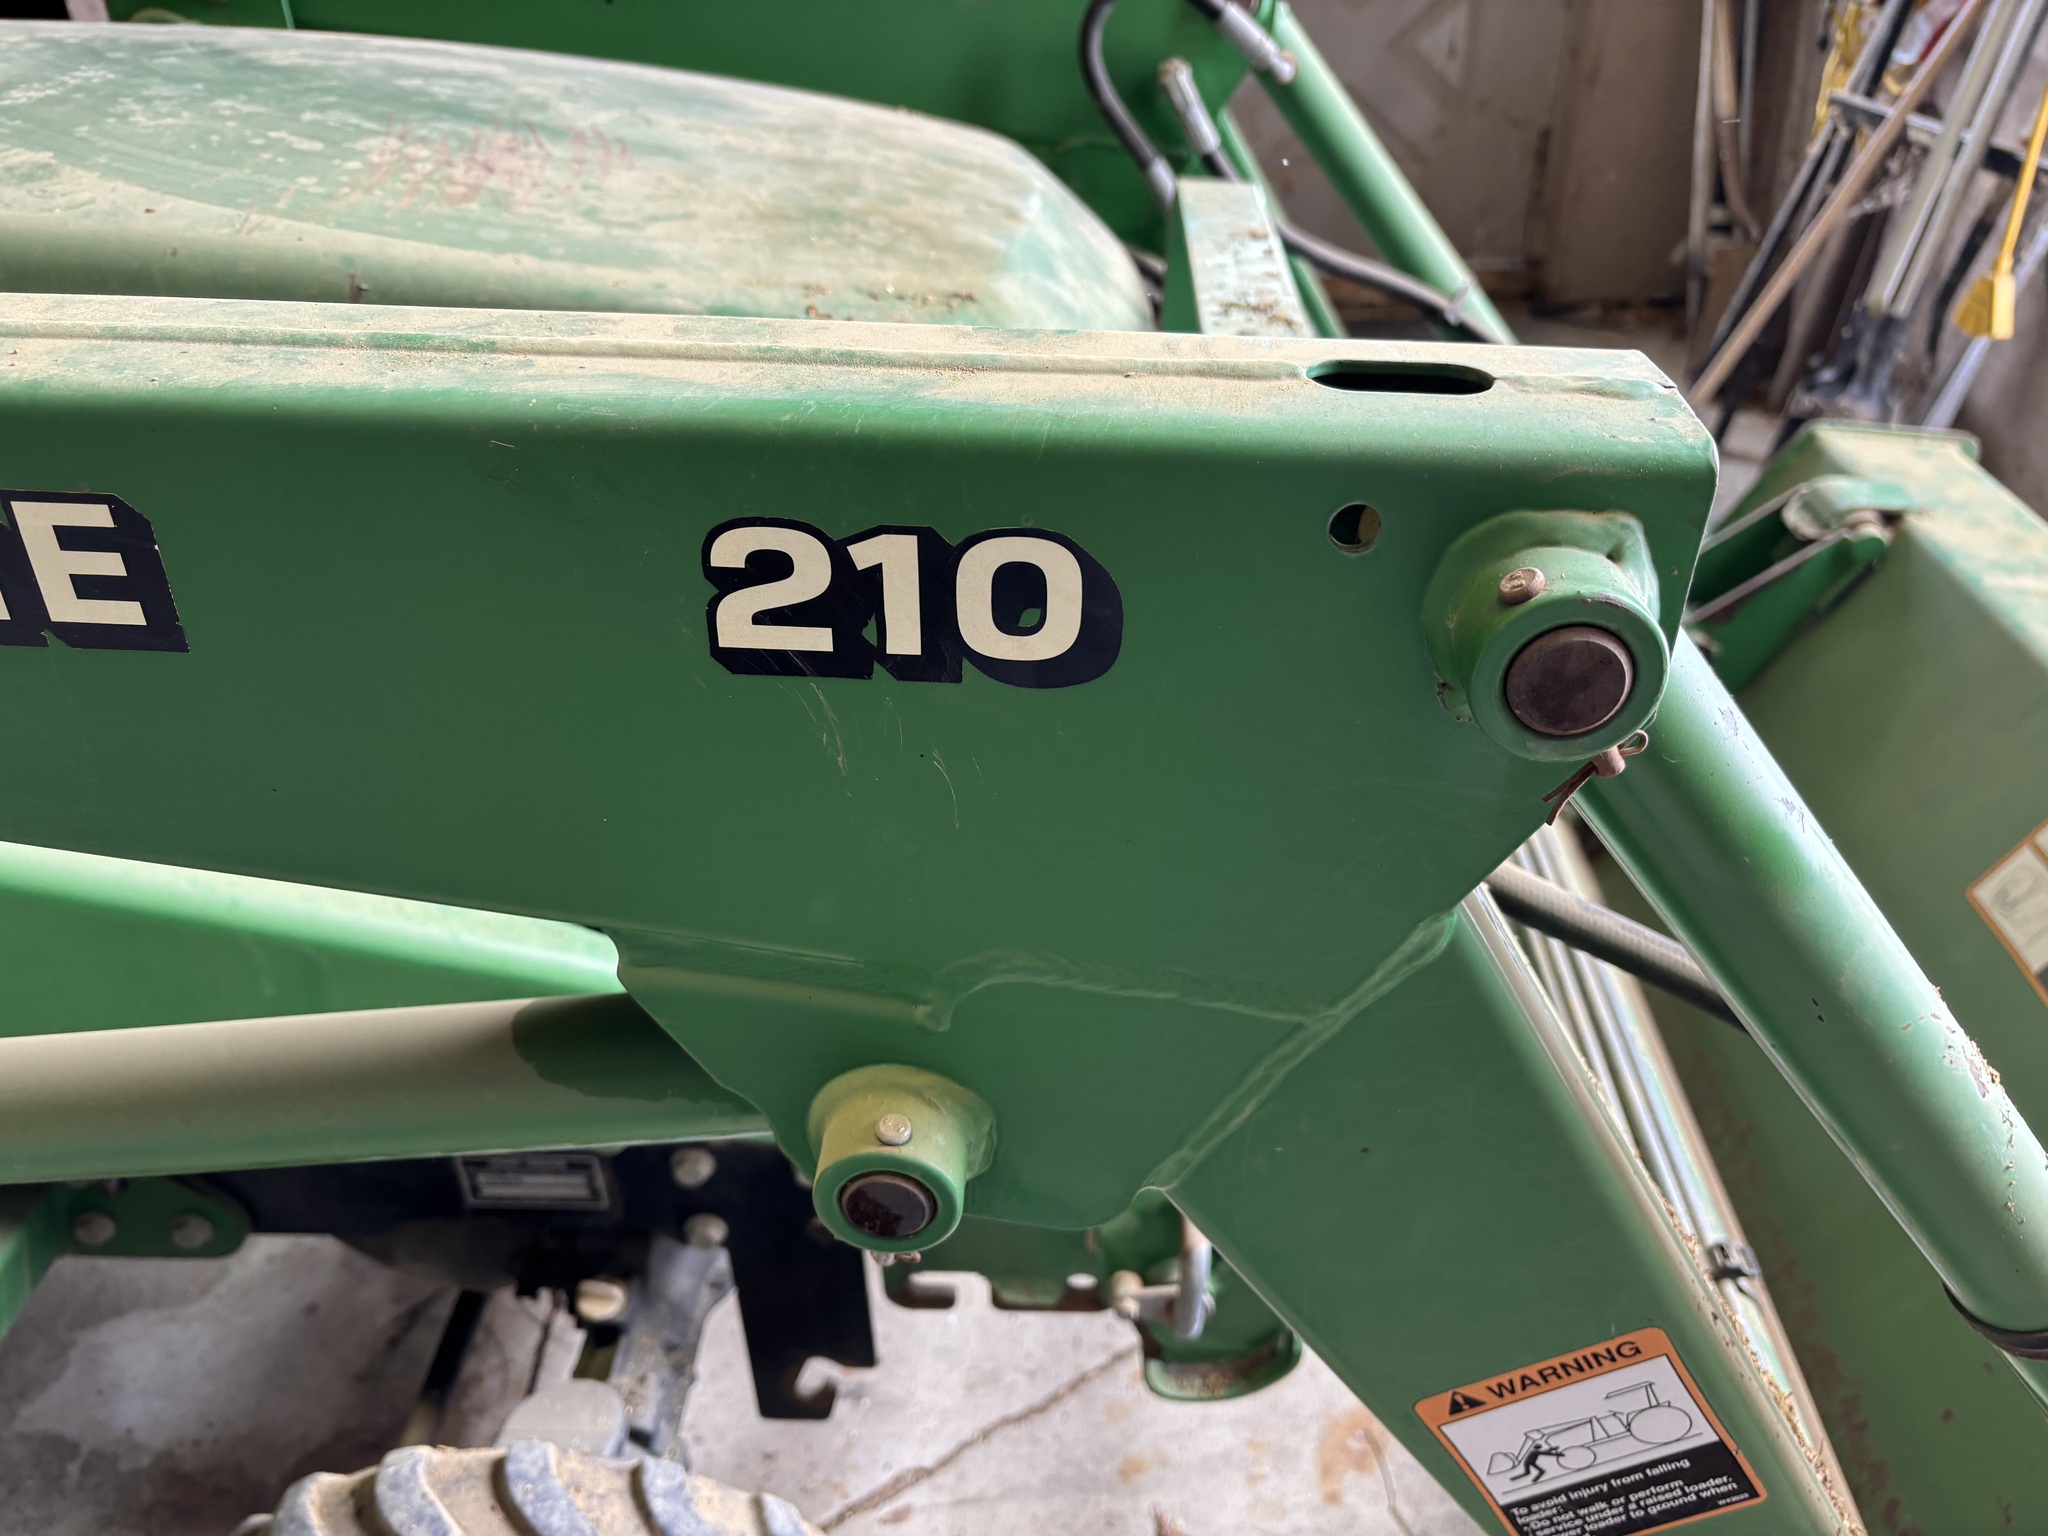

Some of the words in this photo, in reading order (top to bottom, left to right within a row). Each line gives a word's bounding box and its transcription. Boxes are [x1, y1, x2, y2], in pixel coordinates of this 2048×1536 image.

[0, 501, 147, 625] E
[709, 526, 1083, 661] 210
[1485, 1341, 1642, 1399] WARNING
[1510, 1507, 1529, 1517] To
[1530, 1493, 1567, 1512] avoid
[1568, 1482, 1608, 1500] injury
[1610, 1471, 1644, 1488] from
[1645, 1458, 1691, 1478] falling
[1552, 1511, 1576, 1524] not
[1576, 1501, 1609, 1516] walk
[1610, 1496, 1626, 1507] or
[1629, 1479, 1684, 1503] perform
[1584, 1513, 1627, 1532] loader
[1629, 1509, 1645, 1519] to
[1647, 1493, 1697, 1515] ground
[1699, 1482, 1738, 1499] when
[1585, 1505, 1625, 1523] under
[1628, 1502, 1638, 1511] a
[1639, 1487, 1683, 1507] raised
[1516, 1505, 1564, 1525] loader:
